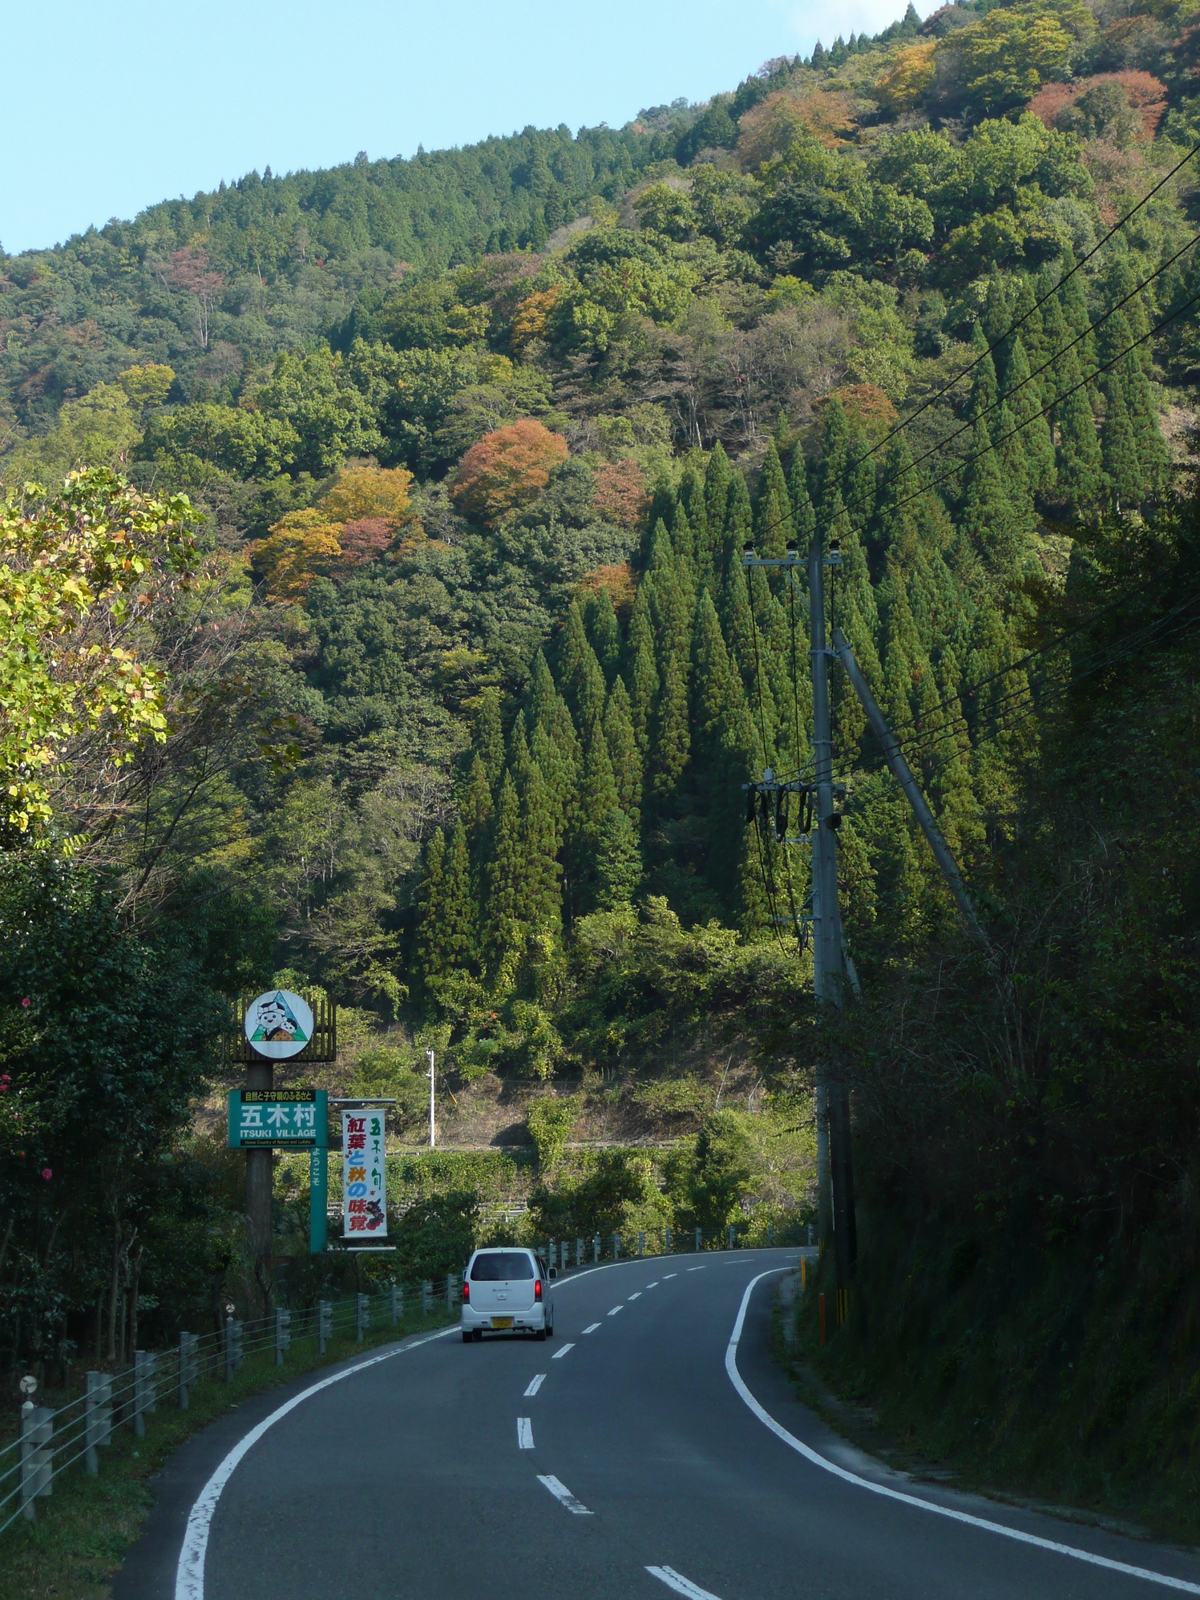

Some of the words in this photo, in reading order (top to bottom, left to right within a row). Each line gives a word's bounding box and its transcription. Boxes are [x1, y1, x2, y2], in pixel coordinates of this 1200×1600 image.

[240, 1103, 316, 1127] 五木村
[240, 1129, 272, 1138] ITSUKI
[276, 1129, 316, 1138] VILLAGE
[312, 1147, 321, 1186] ようこそ
[348, 1117, 367, 1231] 紅葉と秋の味覚
